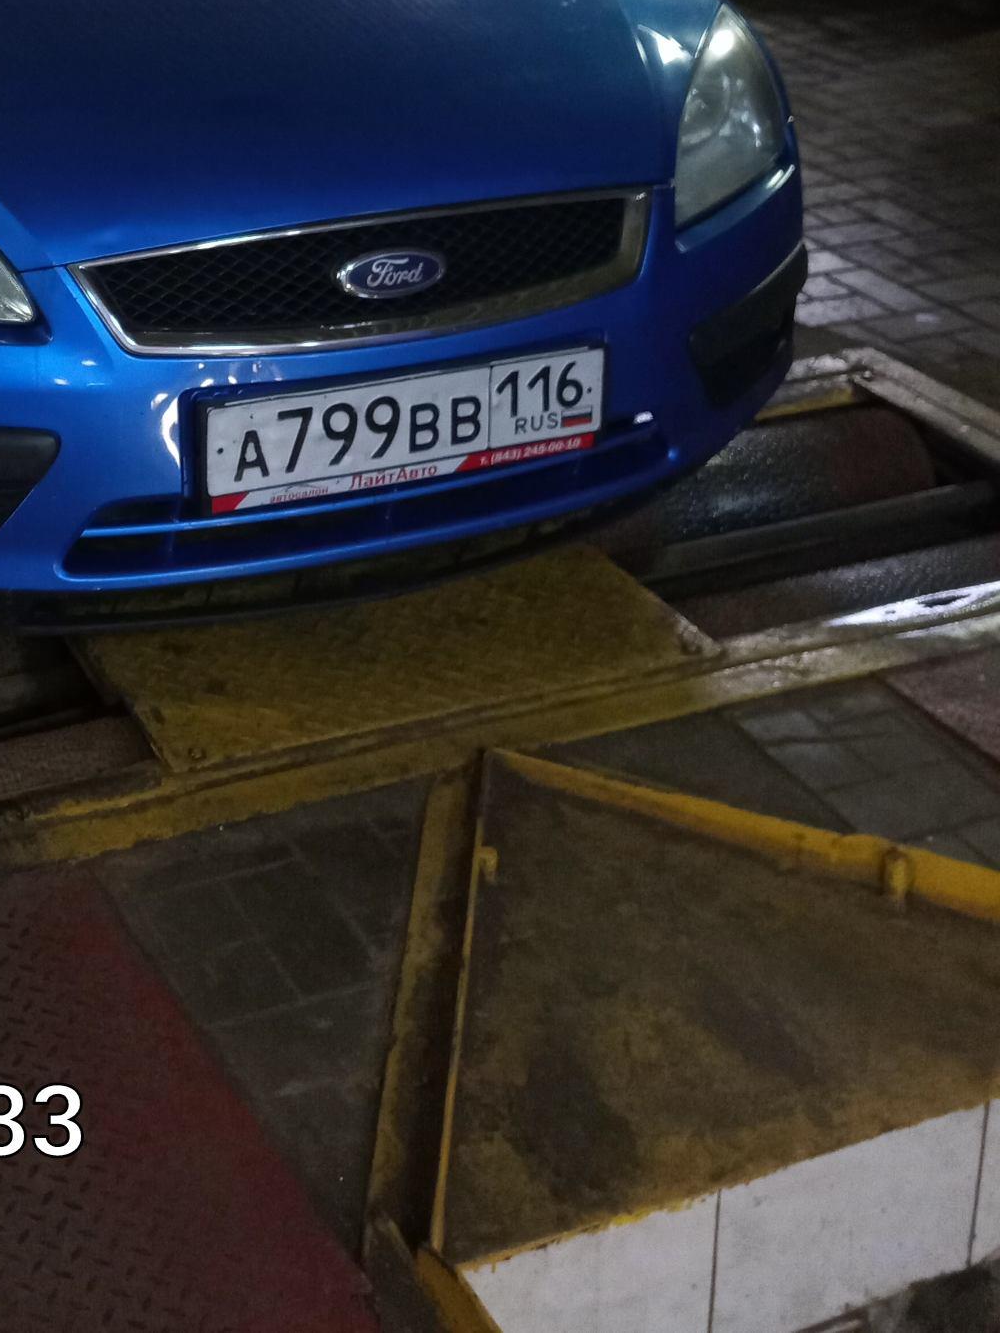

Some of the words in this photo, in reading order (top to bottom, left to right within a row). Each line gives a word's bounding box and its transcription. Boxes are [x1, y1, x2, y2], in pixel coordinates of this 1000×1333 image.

[366, 257, 424, 287] Ford
[496, 361, 584, 417] 116
[513, 412, 559, 435] RUS
[350, 465, 438, 491] ЛайтАвто
